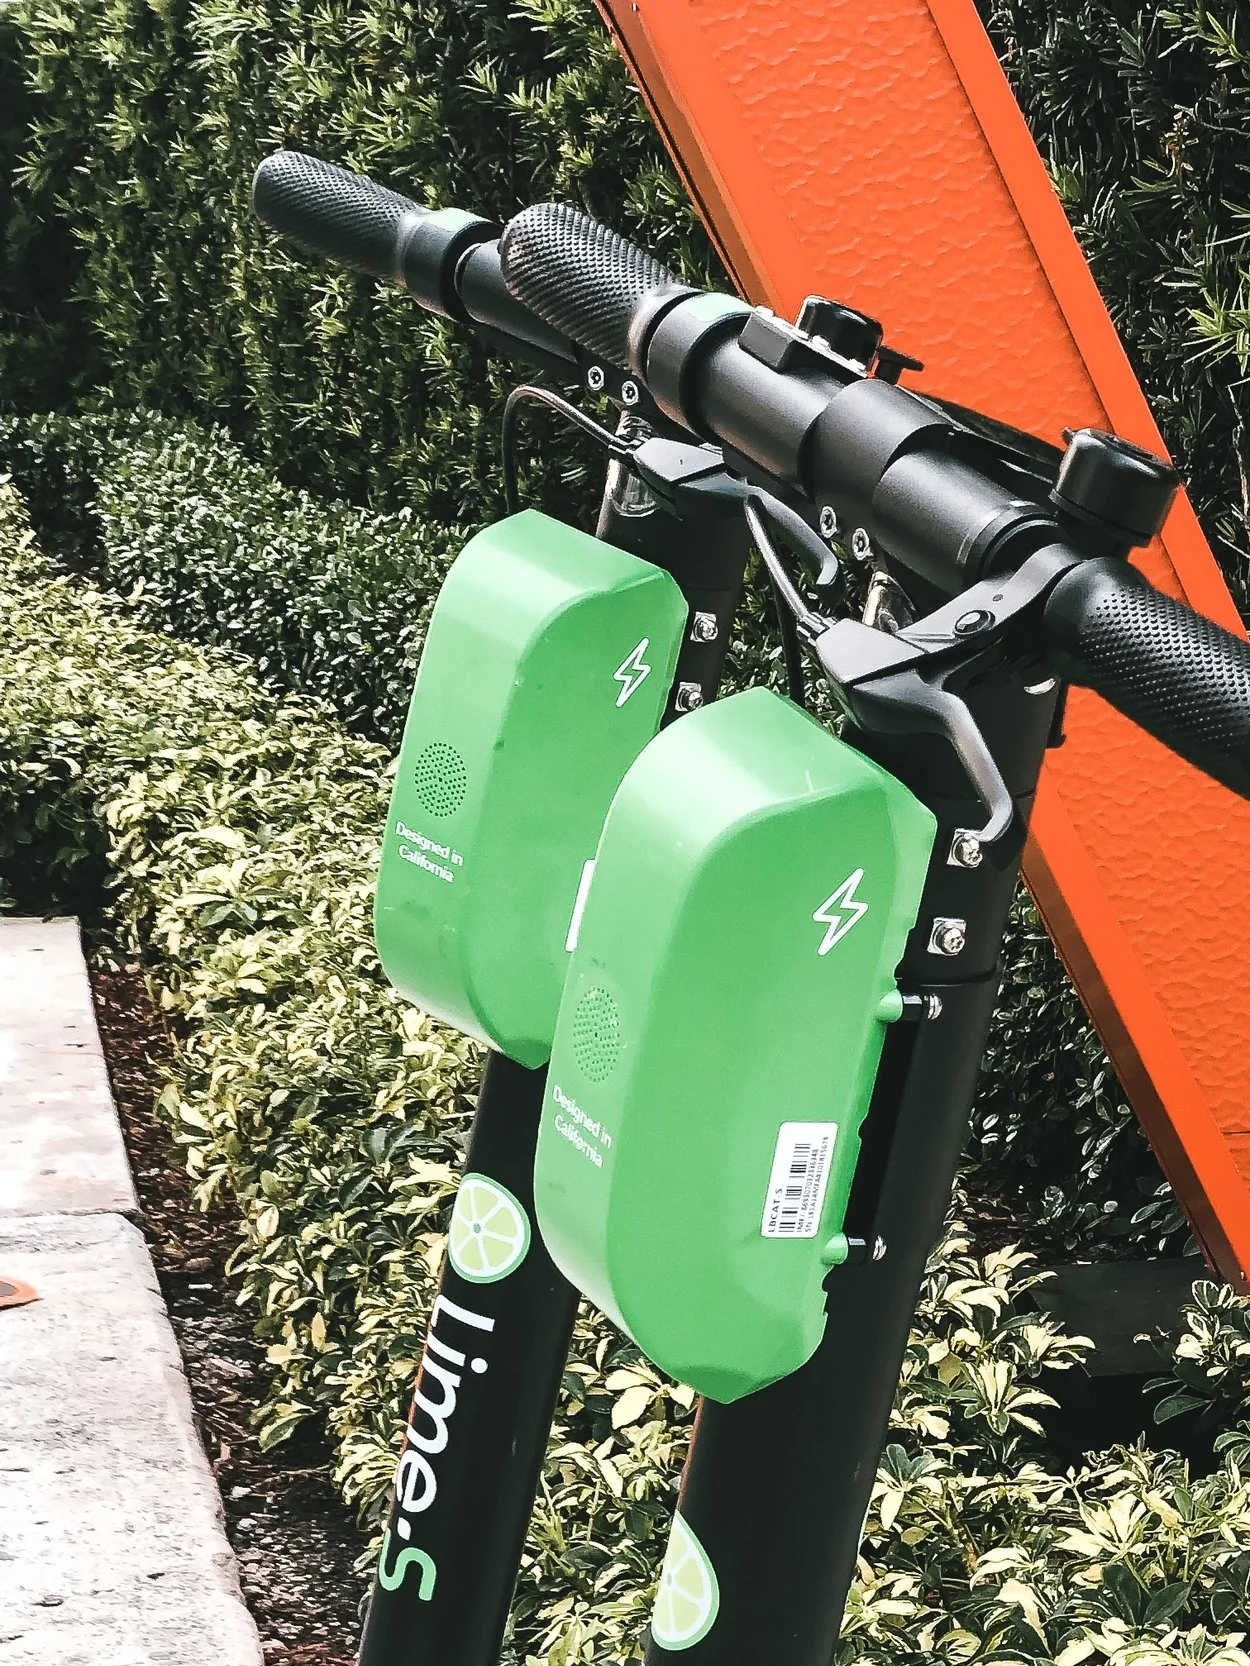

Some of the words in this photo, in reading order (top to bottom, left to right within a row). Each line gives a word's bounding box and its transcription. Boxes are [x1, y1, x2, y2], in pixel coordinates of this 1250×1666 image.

[396, 820, 451, 860] Designed
[451, 849, 464, 867] in
[398, 844, 454, 883] California
[553, 1084, 601, 1138] Designed
[600, 1126, 612, 1149] in
[555, 1113, 603, 1168] California
